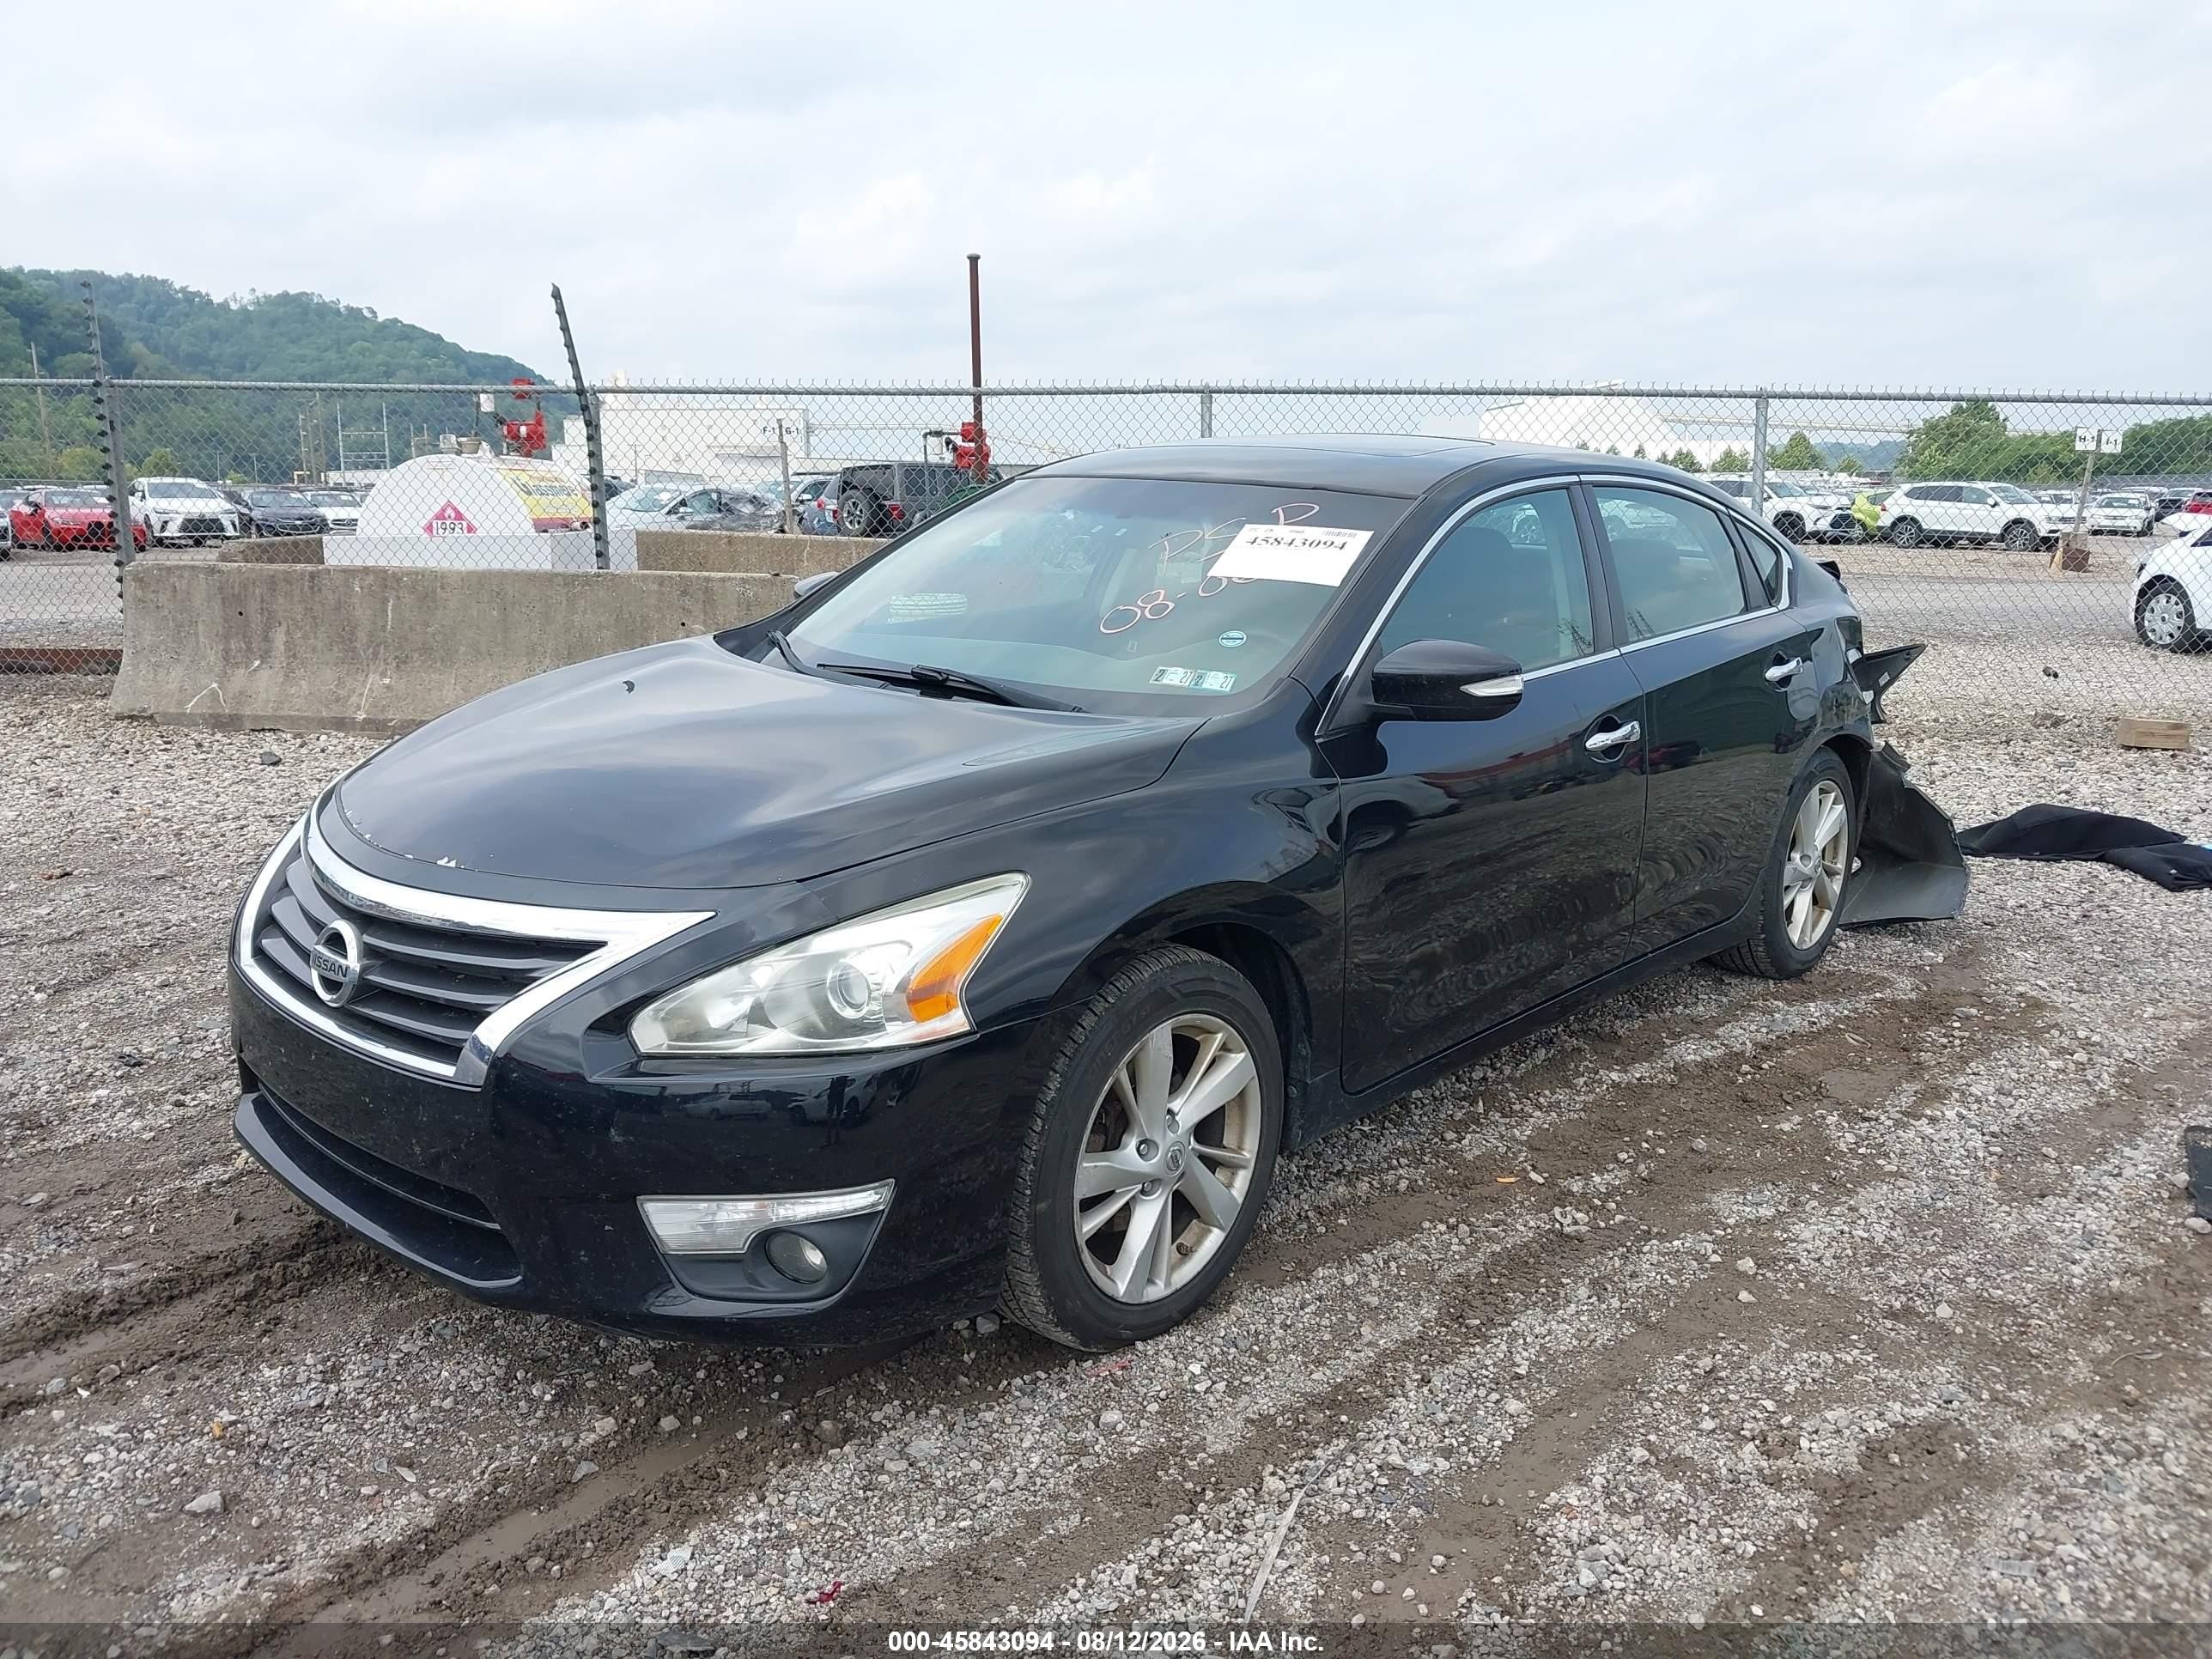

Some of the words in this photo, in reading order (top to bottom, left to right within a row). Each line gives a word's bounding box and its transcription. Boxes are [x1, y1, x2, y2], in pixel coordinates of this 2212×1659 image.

[763, 426, 775, 434] F-1
[434, 521, 465, 536] 1993
[1245, 536, 1348, 550] 45843094
